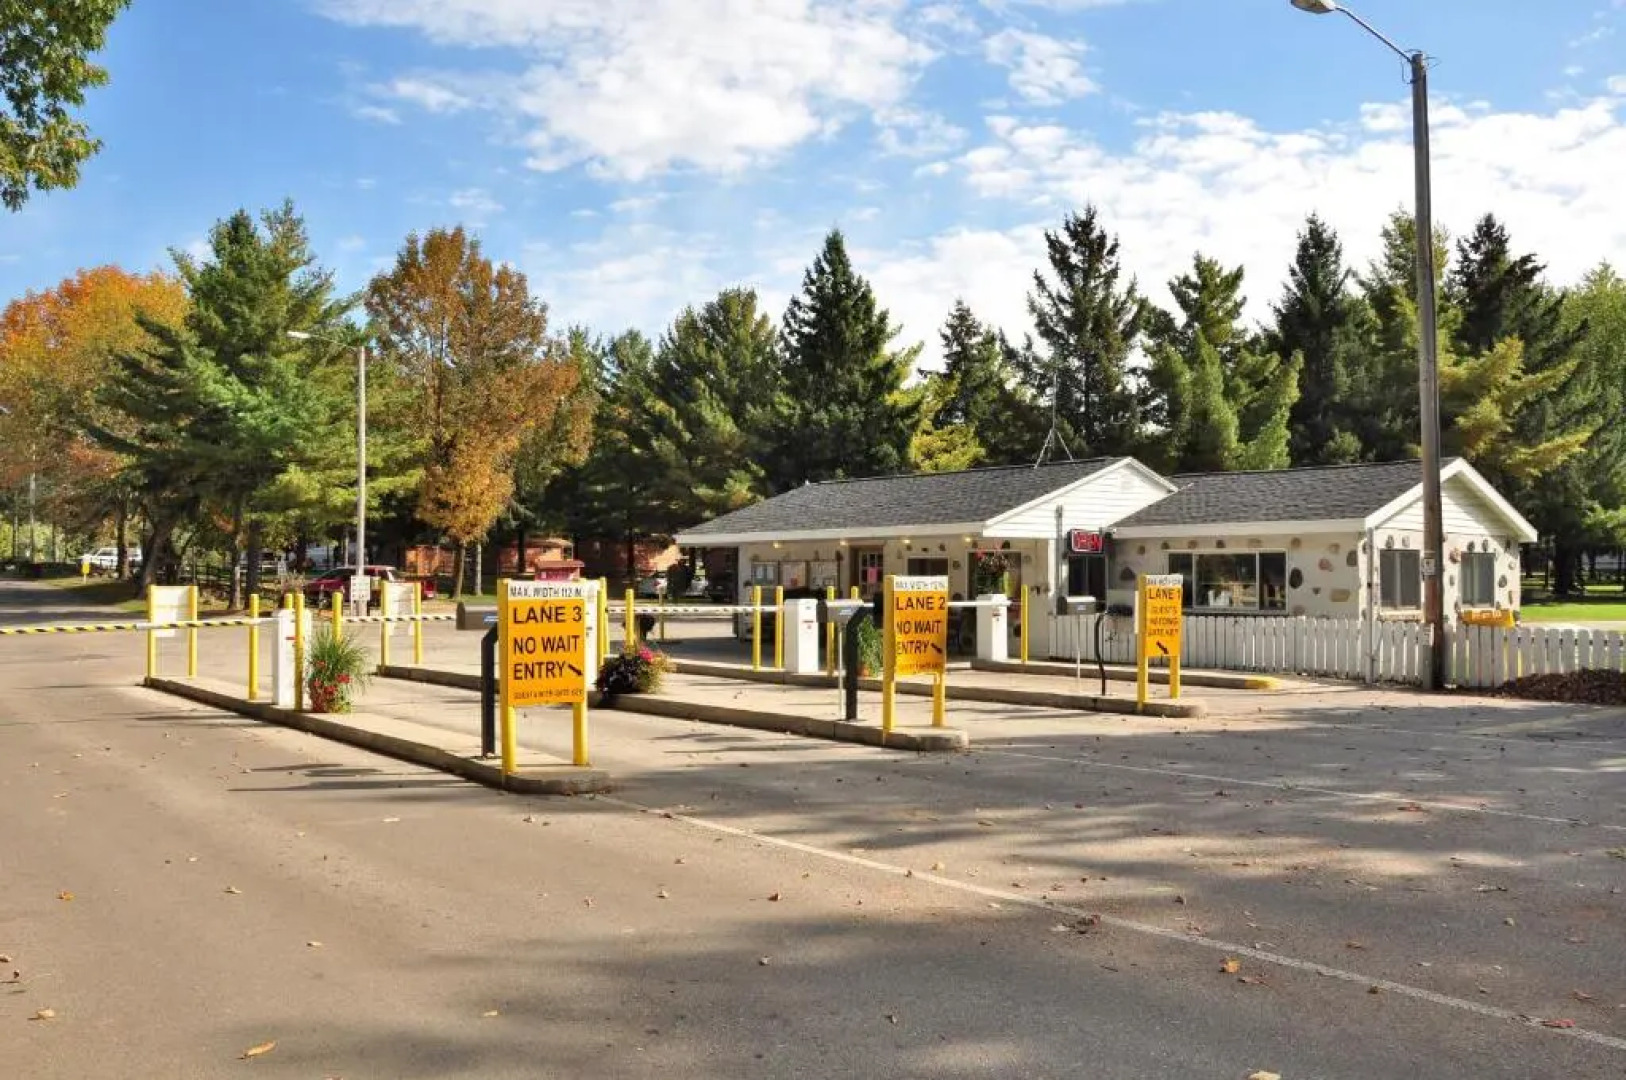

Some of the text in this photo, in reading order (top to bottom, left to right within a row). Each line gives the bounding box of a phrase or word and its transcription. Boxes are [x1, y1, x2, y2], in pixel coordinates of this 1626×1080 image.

[1149, 588, 1174, 600] LANE
[895, 596, 946, 611] LANE 2
[513, 605, 567, 624] LANE
[572, 605, 583, 623] 3
[896, 620, 942, 635] NO WAIT
[513, 634, 580, 655] NO WAIT
[896, 640, 929, 655] ENTRY
[513, 661, 566, 681] ENTRY
